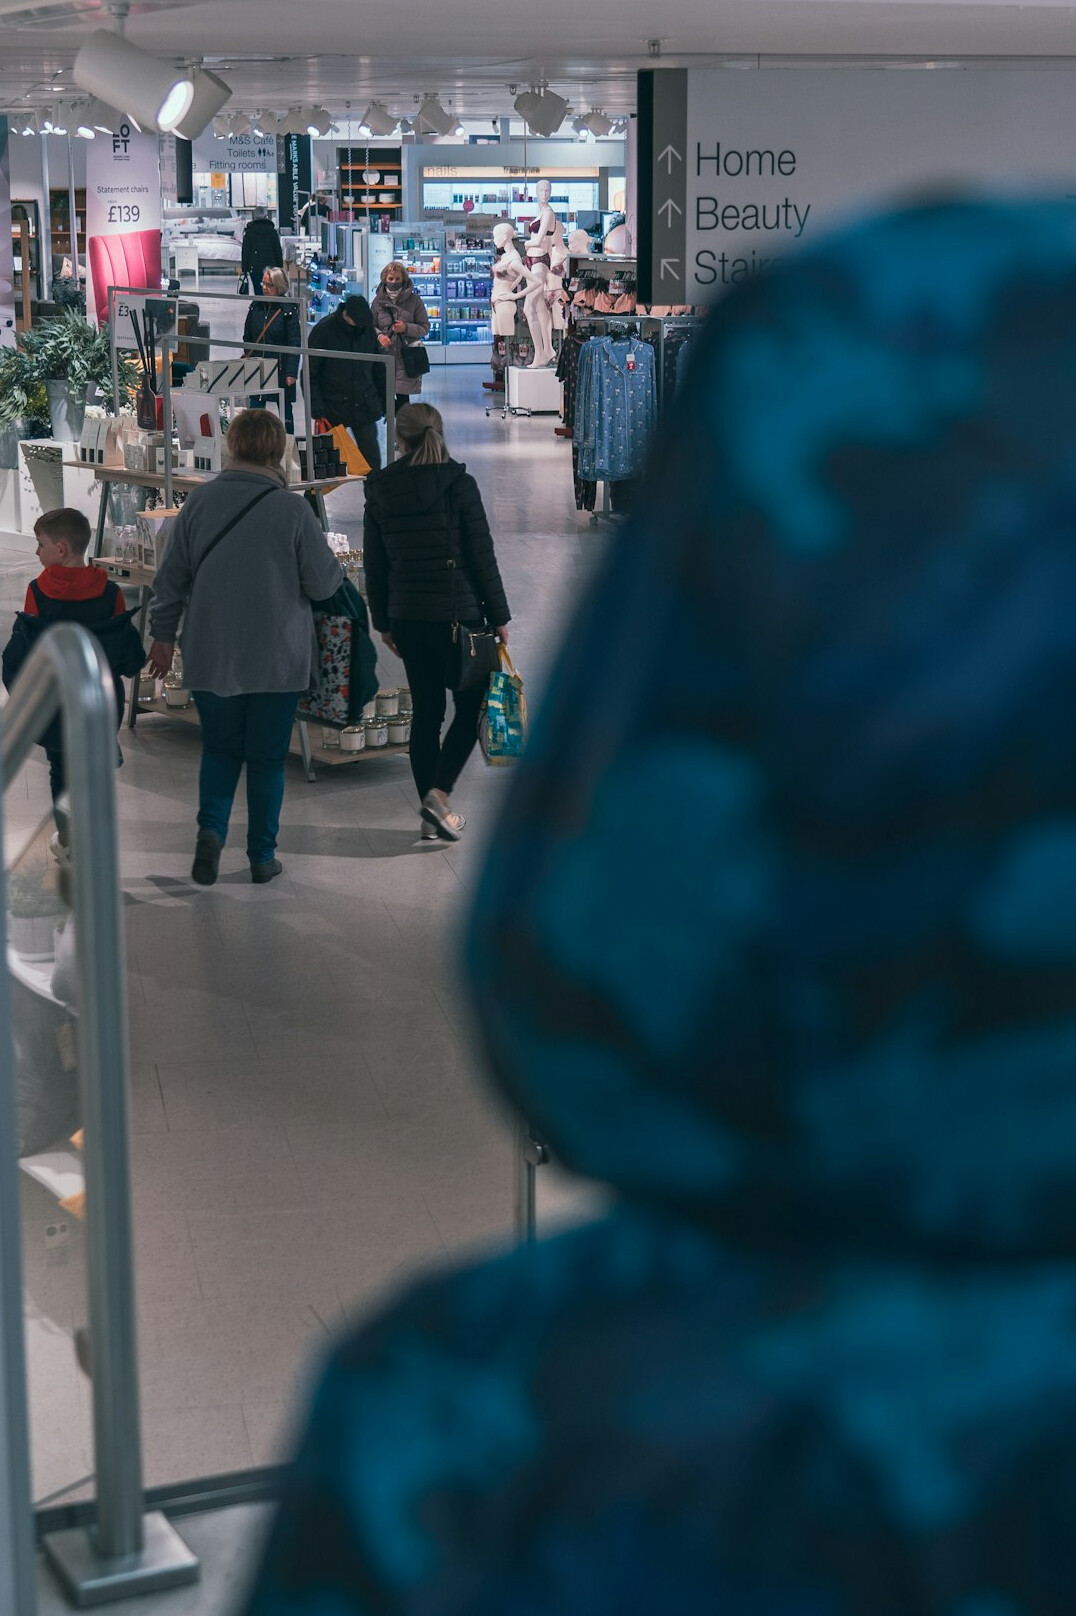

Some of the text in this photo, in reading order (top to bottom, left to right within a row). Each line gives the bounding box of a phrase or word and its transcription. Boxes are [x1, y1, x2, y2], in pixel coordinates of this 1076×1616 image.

[113, 139, 130, 153] FT
[229, 135, 274, 145] M&S Café
[227, 148, 256, 158] Toilets
[697, 142, 796, 176] Home
[209, 161, 267, 171] Fitting rooms
[427, 164, 458, 177] nails
[97, 185, 149, 194] Statement chairs
[108, 205, 140, 223] £139
[696, 196, 810, 238] Beauty
[118, 306, 129, 317] £3
